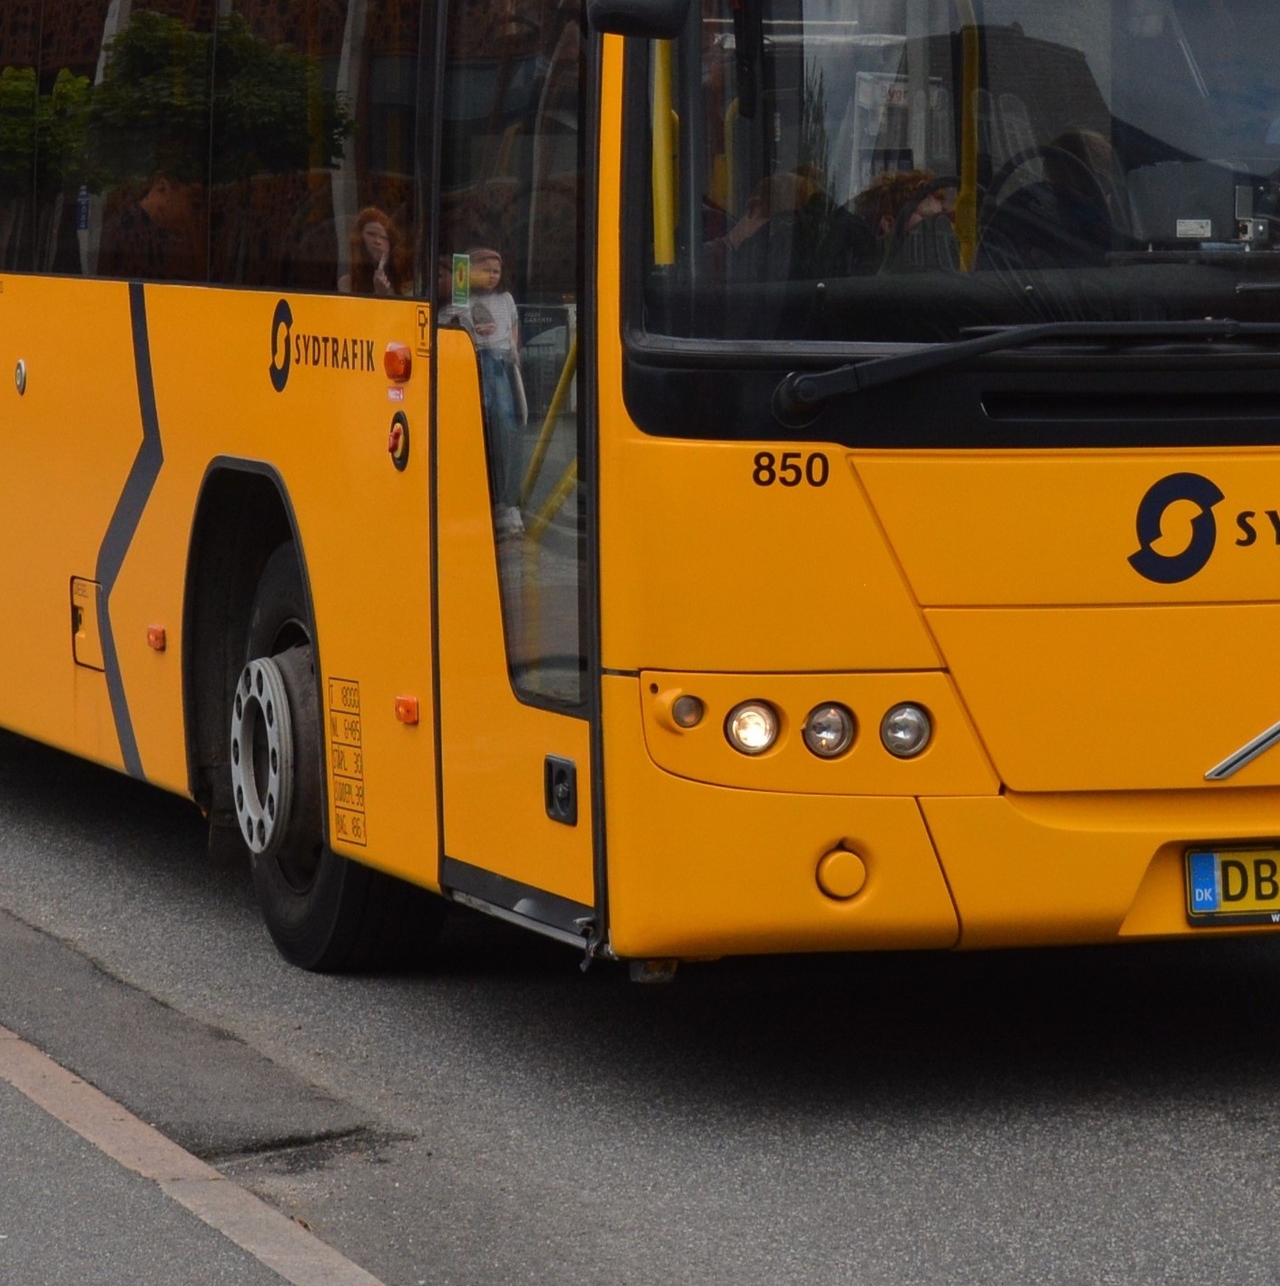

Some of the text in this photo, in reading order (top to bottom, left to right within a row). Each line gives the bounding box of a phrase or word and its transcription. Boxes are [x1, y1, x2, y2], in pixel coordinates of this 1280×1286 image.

[294, 333, 376, 372] SYDTRAFIK
[751, 452, 830, 488] 850
[1195, 888, 1213, 902] DK
[1220, 858, 1279, 902] DB
